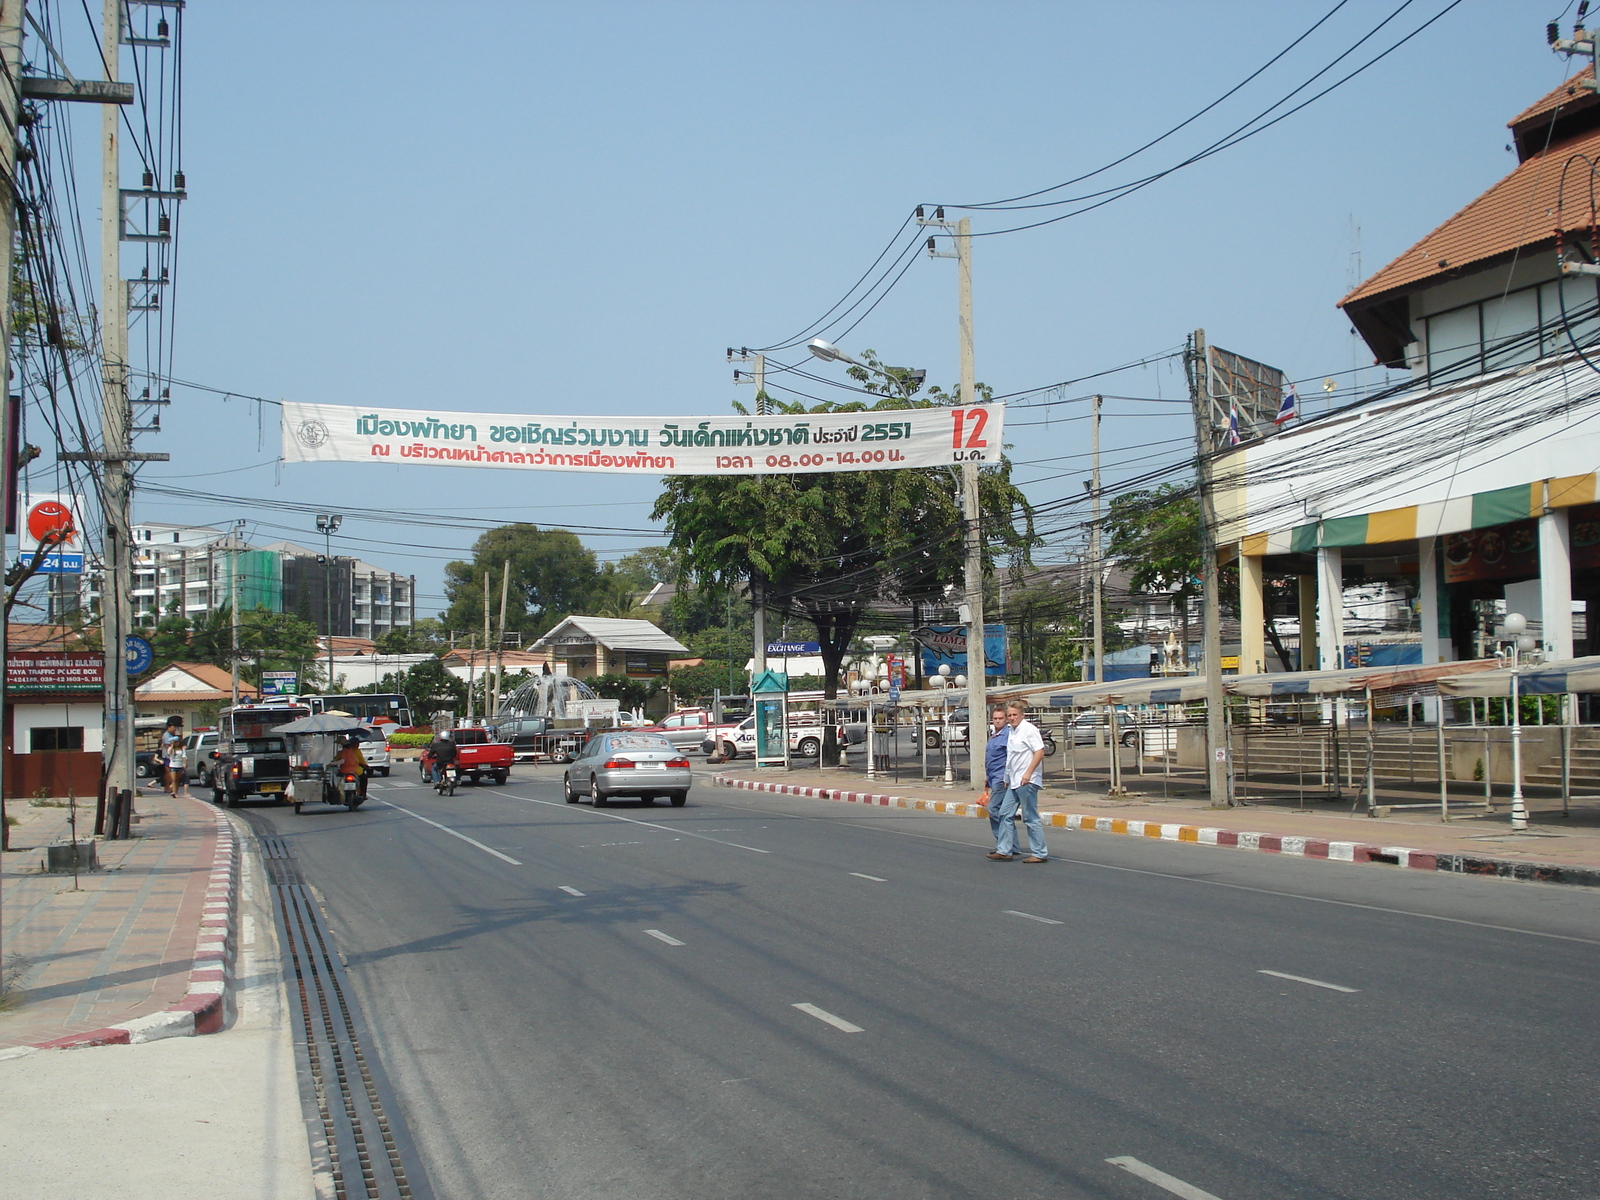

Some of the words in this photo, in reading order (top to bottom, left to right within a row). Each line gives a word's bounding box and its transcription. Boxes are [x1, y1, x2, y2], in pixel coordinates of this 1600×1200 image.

[356, 414, 477, 441] เมืองพัทยา
[489, 421, 649, 446] ขอเชิญร่วมงาน
[659, 421, 810, 447] วันเด็กแห่งชาติ
[813, 425, 858, 444] ประจำปี
[861, 422, 911, 441] 2551
[951, 408, 988, 449] 12
[371, 444, 389, 456] ณ
[400, 443, 674, 468] บริเวณหน้าศาลาว่าการเมืองพัทยา
[716, 455, 753, 468] เวลา
[953, 450, 985, 462] ม.ค.
[42, 558, 59, 568] 24
[767, 644, 805, 652] EXCHANGE
